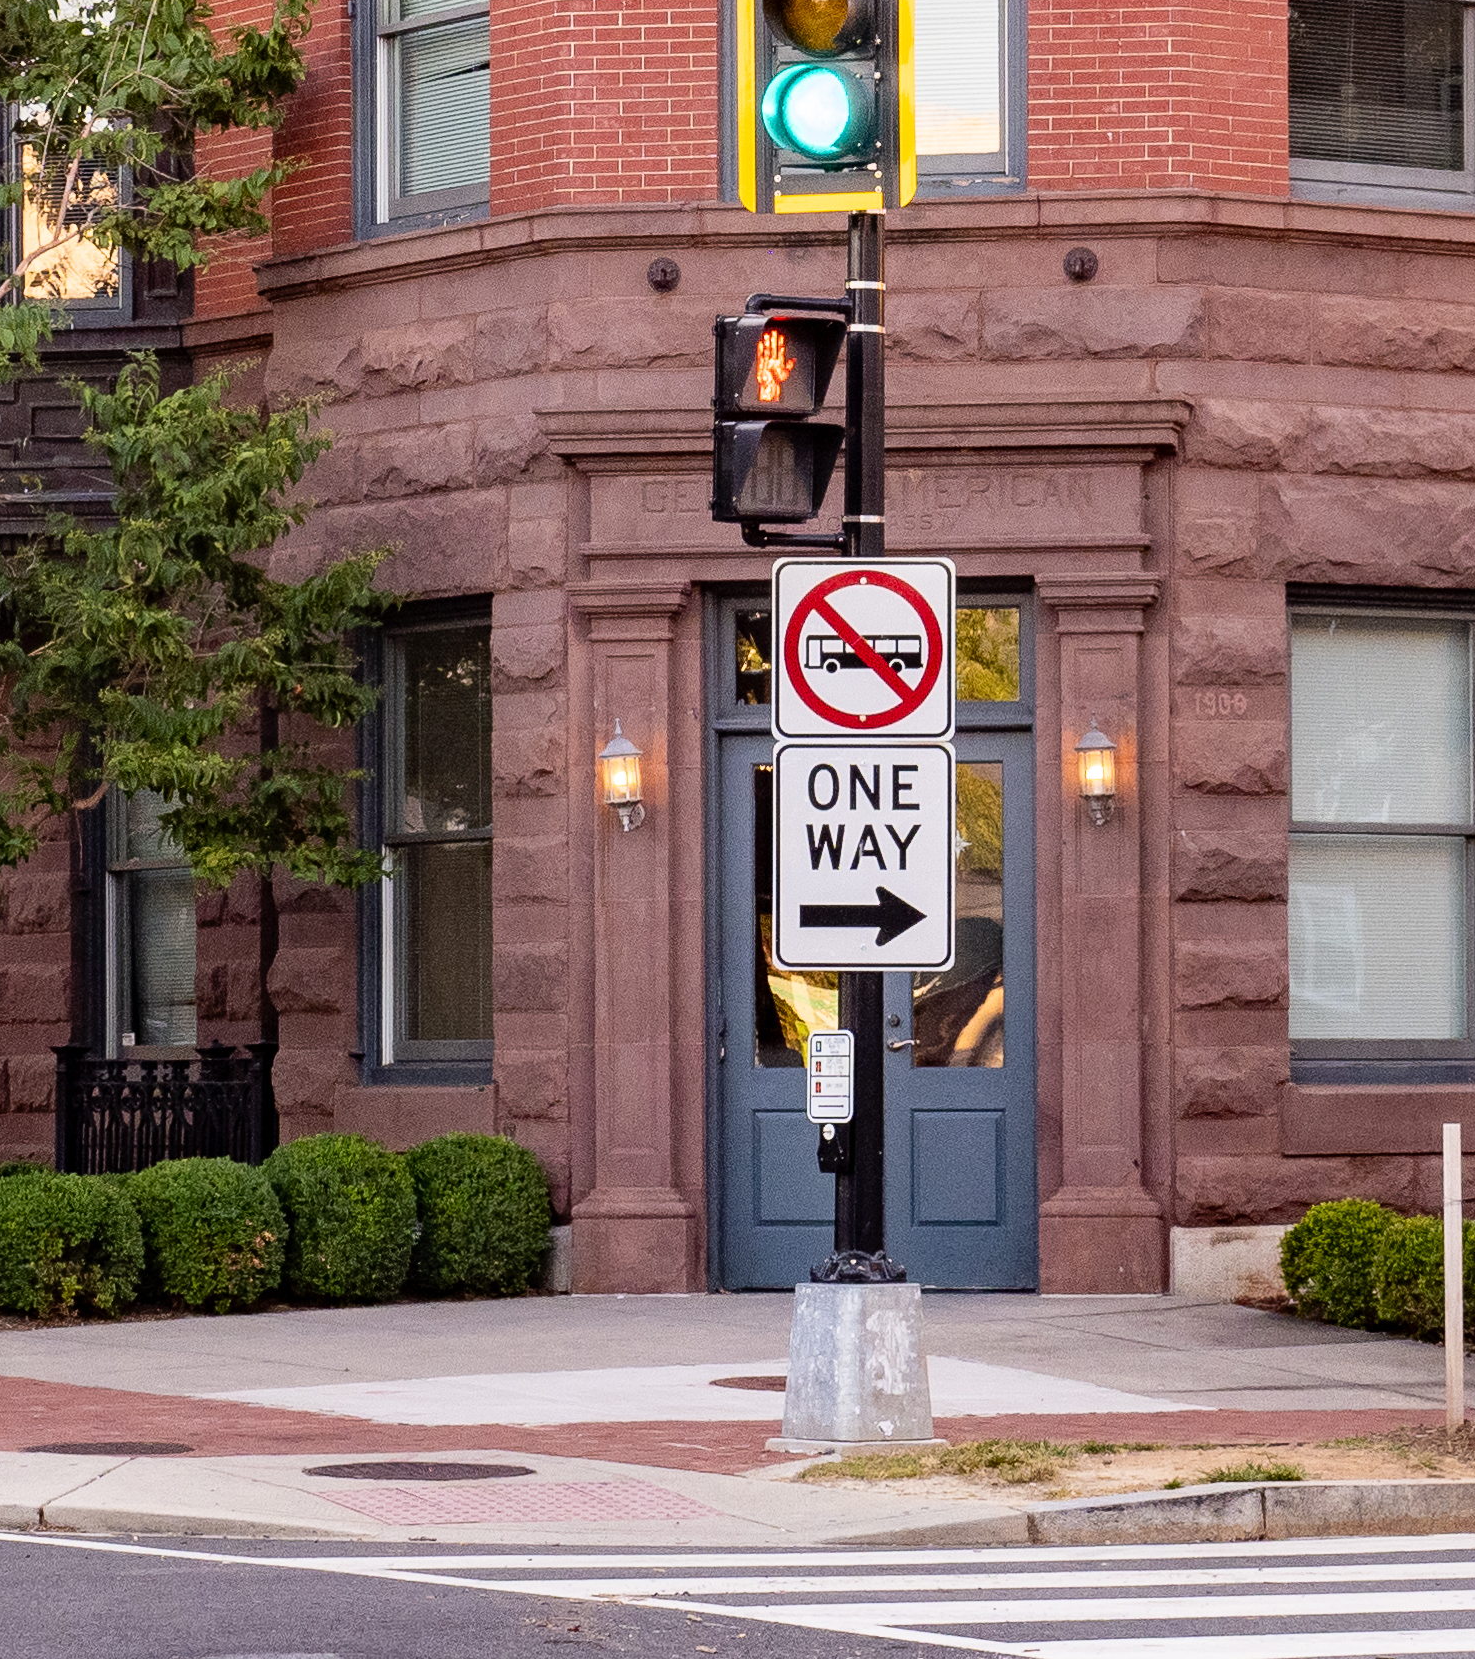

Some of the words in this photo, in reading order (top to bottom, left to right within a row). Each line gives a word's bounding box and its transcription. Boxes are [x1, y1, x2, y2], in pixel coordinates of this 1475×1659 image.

[888, 472, 1094, 510] MERICAN
[808, 764, 920, 811] ONE
[806, 823, 922, 871] WAY
